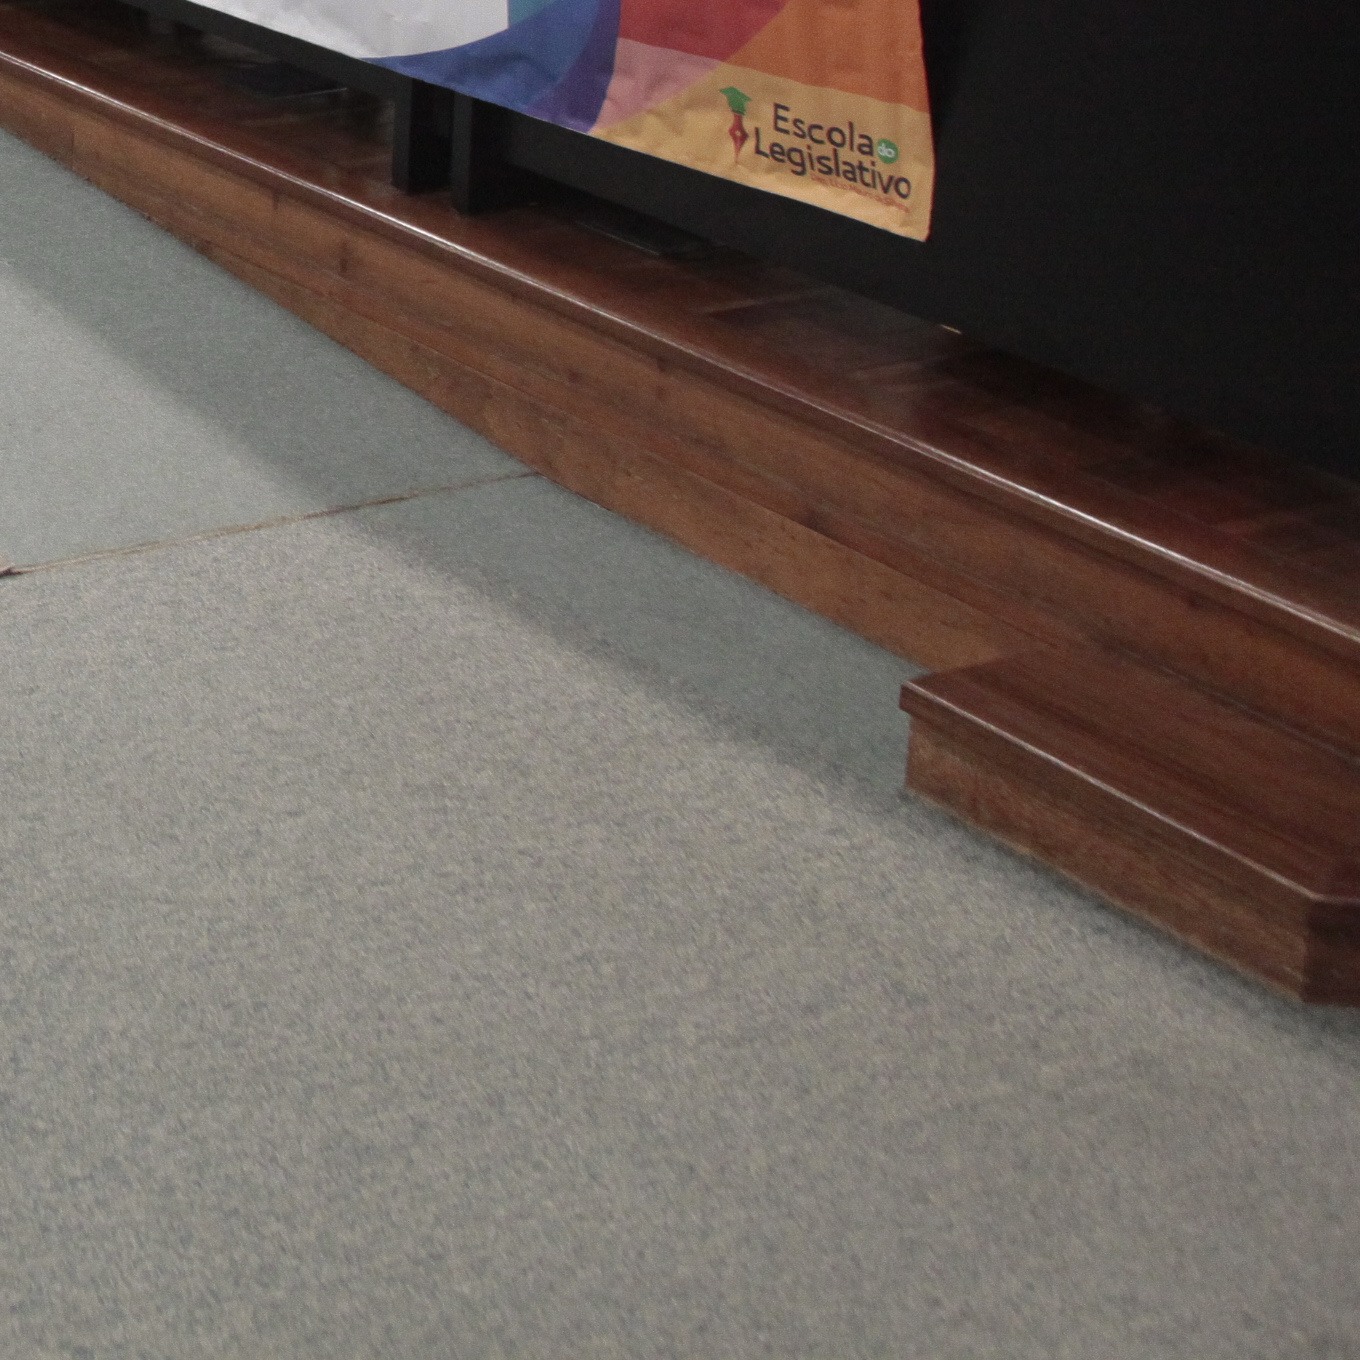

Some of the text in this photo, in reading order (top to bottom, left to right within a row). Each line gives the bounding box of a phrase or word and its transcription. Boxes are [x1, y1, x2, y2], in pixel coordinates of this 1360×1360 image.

[754, 126, 912, 200] Legislativo
[773, 102, 896, 159] Escola do
